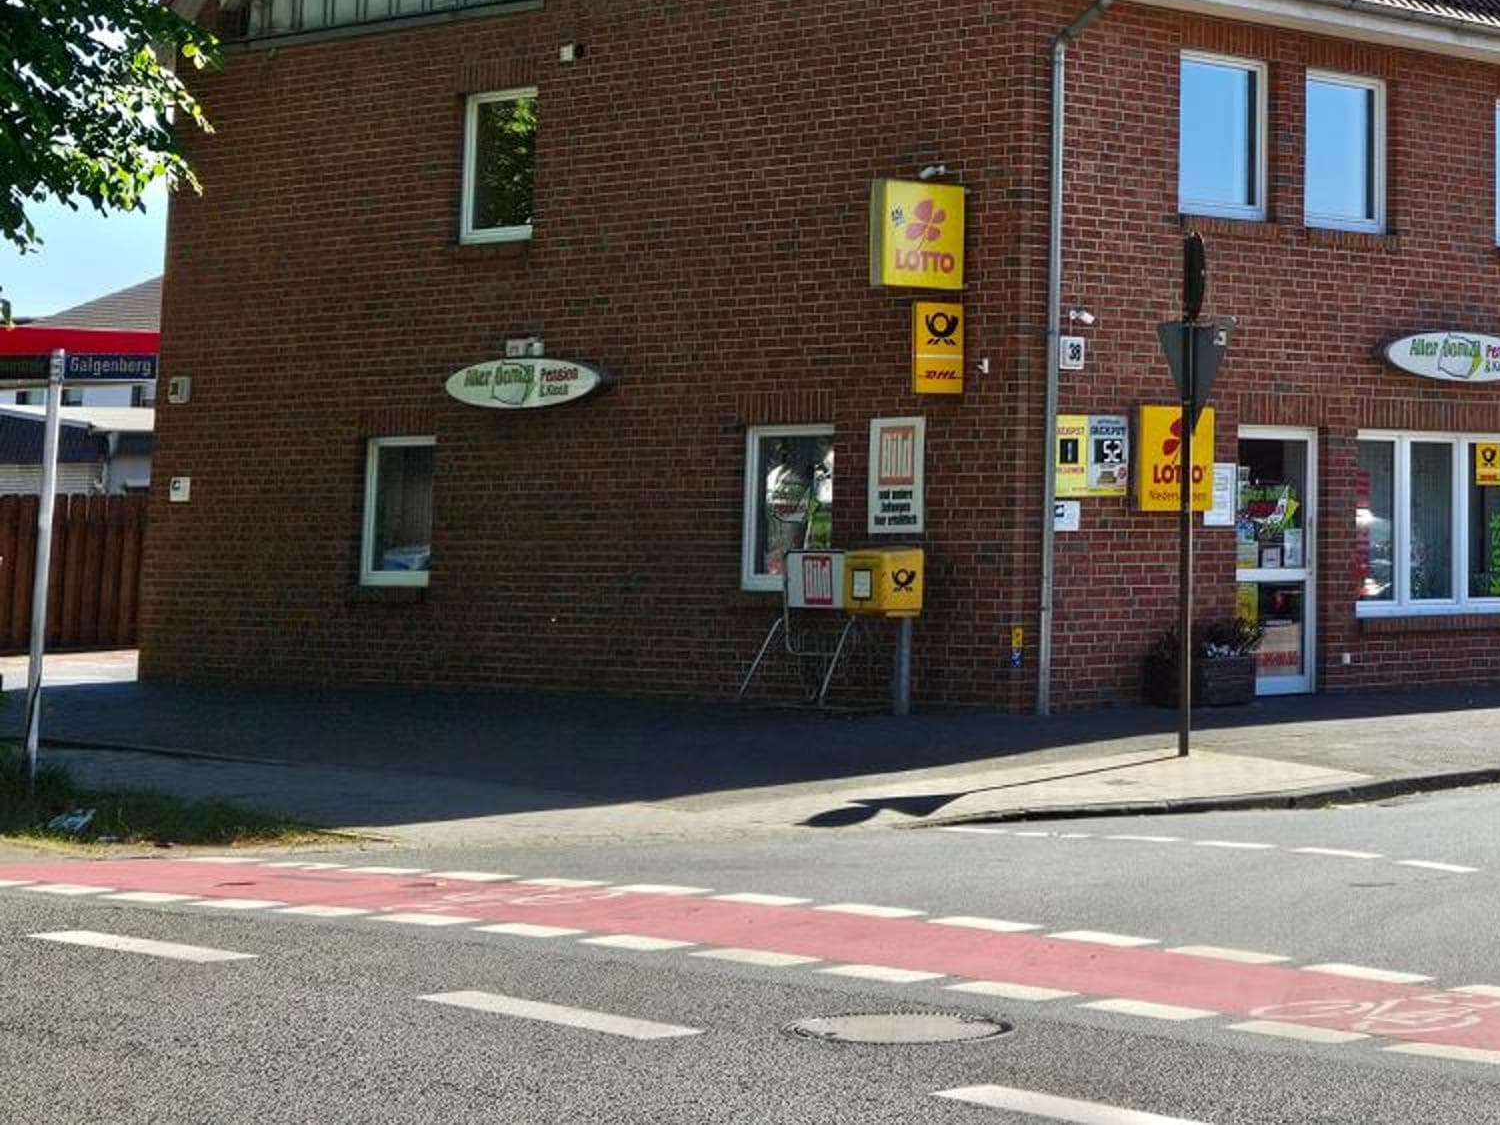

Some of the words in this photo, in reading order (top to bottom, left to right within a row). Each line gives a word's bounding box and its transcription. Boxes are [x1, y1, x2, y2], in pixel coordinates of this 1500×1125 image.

[895, 250, 955, 273] LOTTO
[70, 356, 151, 376] Galgenberg
[924, 370, 958, 380] DHL
[1103, 441, 1121, 462] 52
[1153, 464, 1203, 484] LOTO
